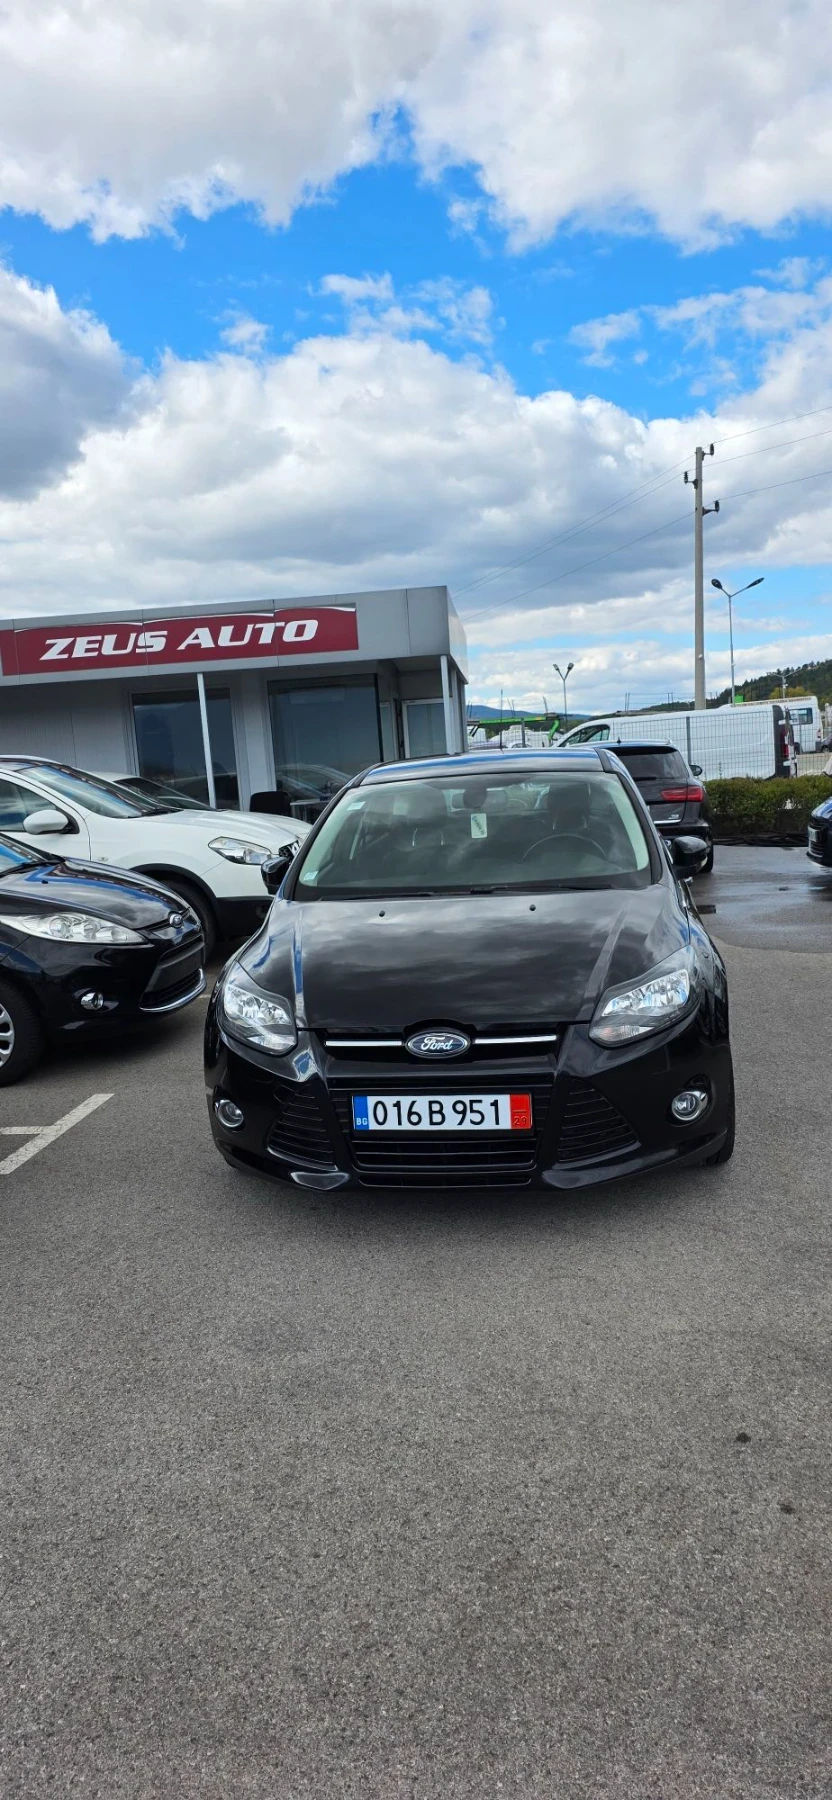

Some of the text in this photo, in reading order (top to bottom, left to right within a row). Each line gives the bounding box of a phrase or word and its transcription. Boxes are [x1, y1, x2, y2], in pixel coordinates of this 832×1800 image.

[39, 619, 319, 661] ZEUS AUTO
[421, 1036, 454, 1050] Ford
[356, 1117, 368, 1126] BG
[514, 1115, 527, 1126] 29
